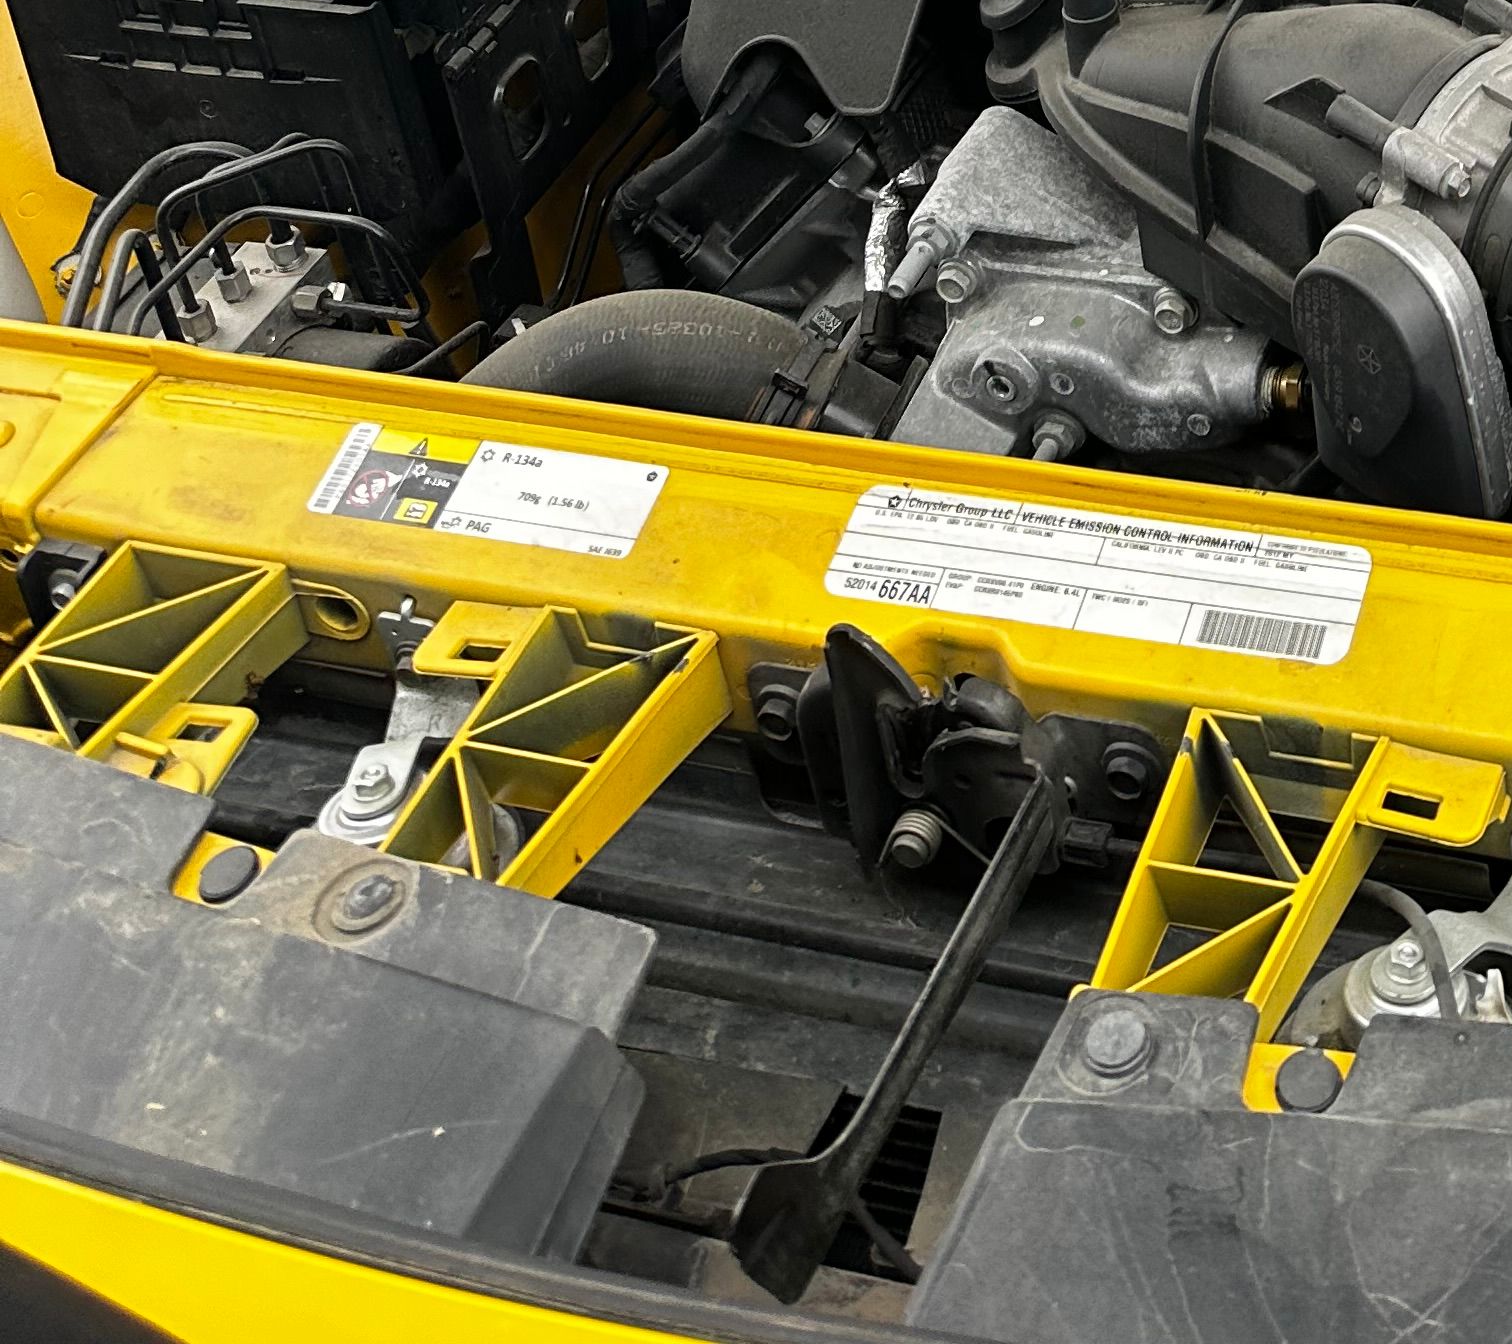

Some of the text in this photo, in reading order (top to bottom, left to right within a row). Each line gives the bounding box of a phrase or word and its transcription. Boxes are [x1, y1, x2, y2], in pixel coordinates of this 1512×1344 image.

[502, 452, 543, 469] R-134a
[517, 491, 542, 506] 709g
[465, 519, 492, 534] PAG
[907, 497, 1253, 552] Chrysler Group LLC VEHICLE EMISSION CONTROL INFORMATION
[843, 577, 933, 604] 52014 667AA
